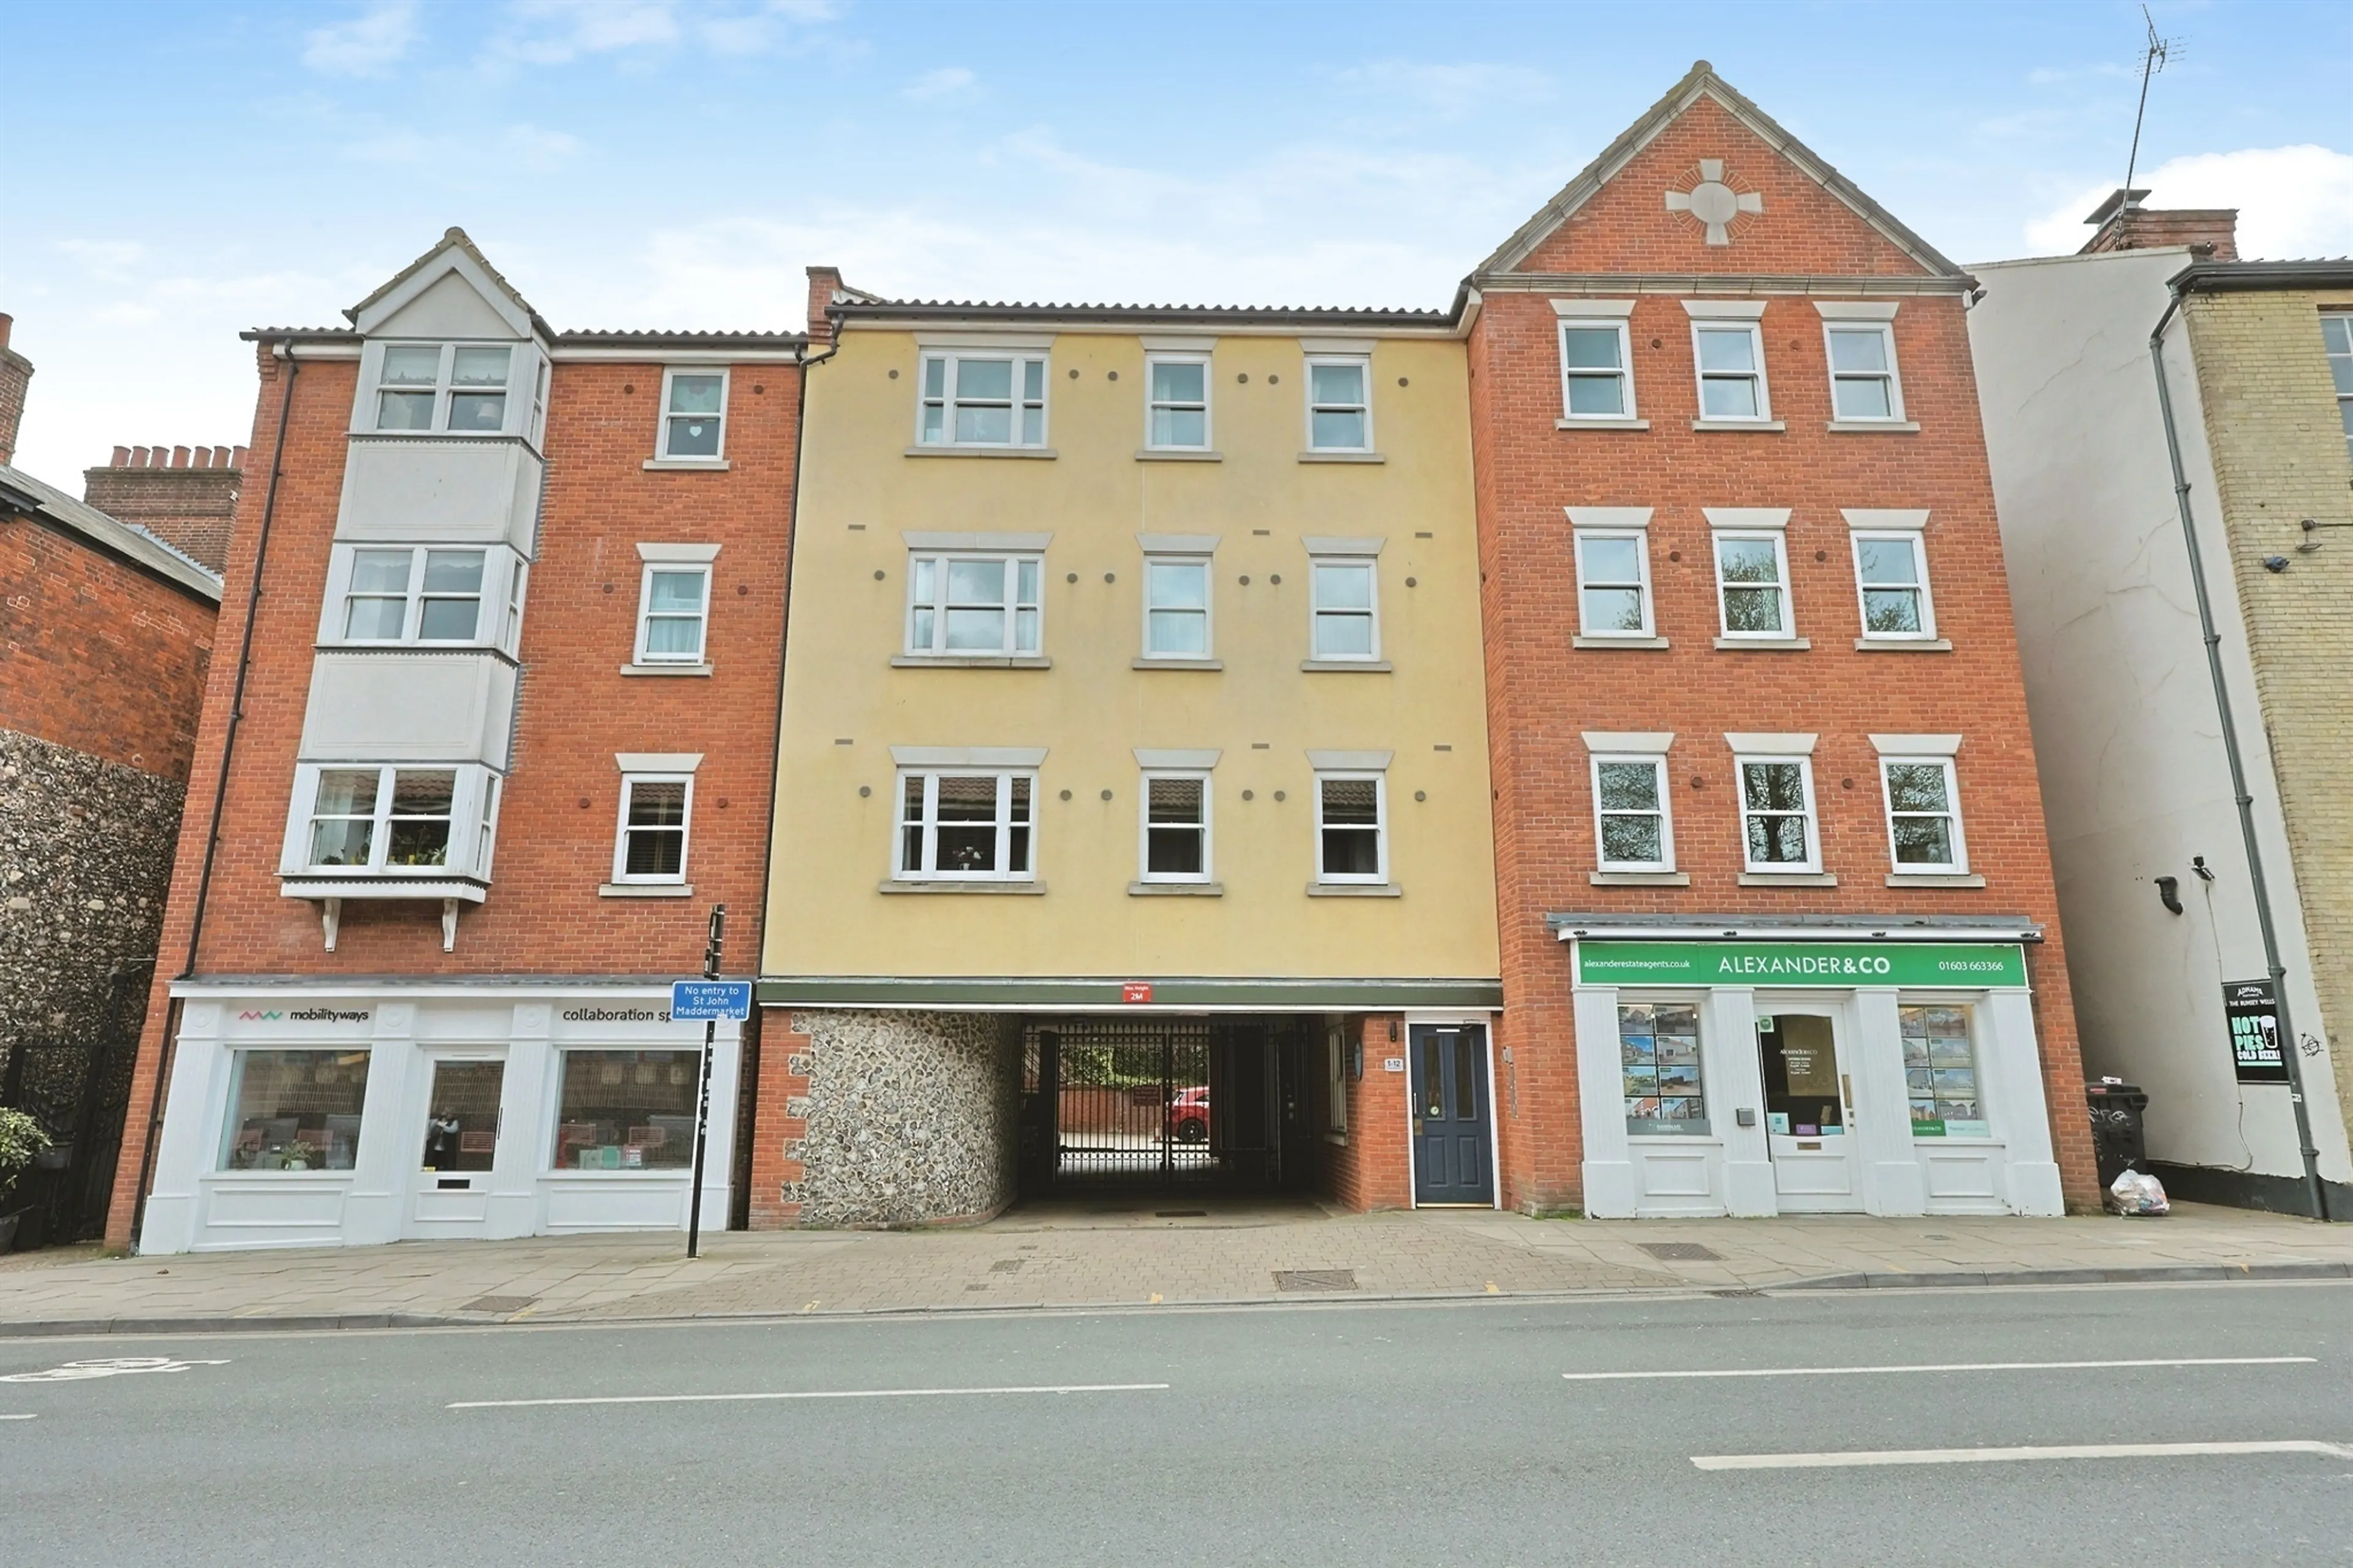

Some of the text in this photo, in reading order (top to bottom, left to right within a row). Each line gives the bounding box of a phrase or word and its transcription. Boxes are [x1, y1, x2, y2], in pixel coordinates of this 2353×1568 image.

[1584, 960, 1691, 969] alexanderestateagents.co.uk
[1718, 956, 1891, 974] ALEXANDER&CO
[1938, 961, 2004, 971] 01603 663366
[684, 986, 699, 994] No
[702, 987, 726, 996] entry
[693, 996, 729, 1005] St John
[290, 1008, 369, 1023] mobilityways
[563, 1008, 654, 1021] collaboration
[676, 1007, 745, 1015] Maddermarket
[2231, 1016, 2259, 1034] HOT
[2234, 1035, 2265, 1051] PIES
[2237, 1050, 2281, 1060] COLD BEER!
